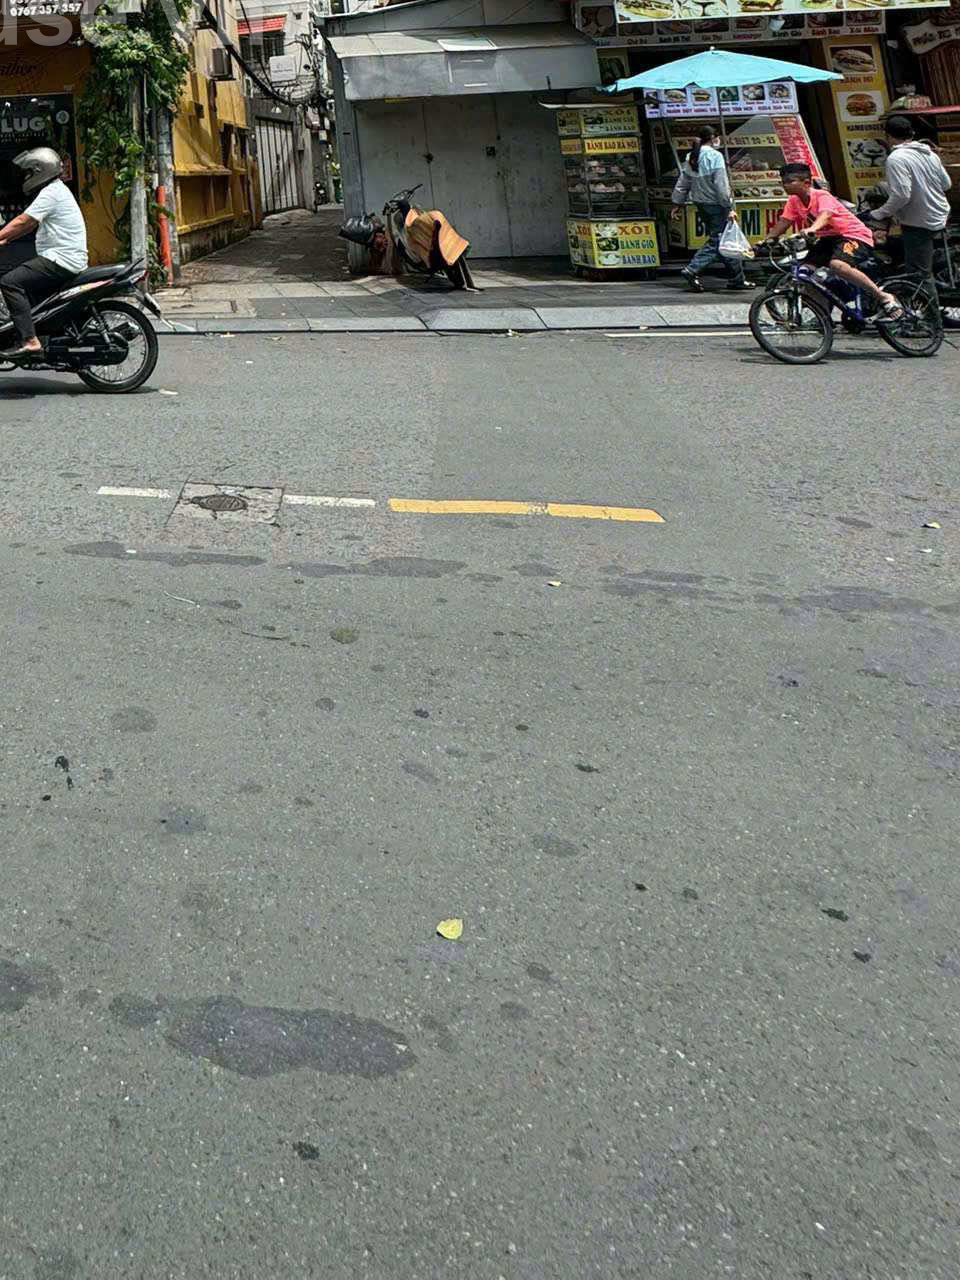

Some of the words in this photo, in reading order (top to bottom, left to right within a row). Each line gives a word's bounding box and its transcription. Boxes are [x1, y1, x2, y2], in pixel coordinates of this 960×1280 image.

[9, 6, 37, 17] 0767
[39, 4, 59, 15] 357
[60, 2, 82, 13] 357
[617, 222, 650, 236] XÔI
